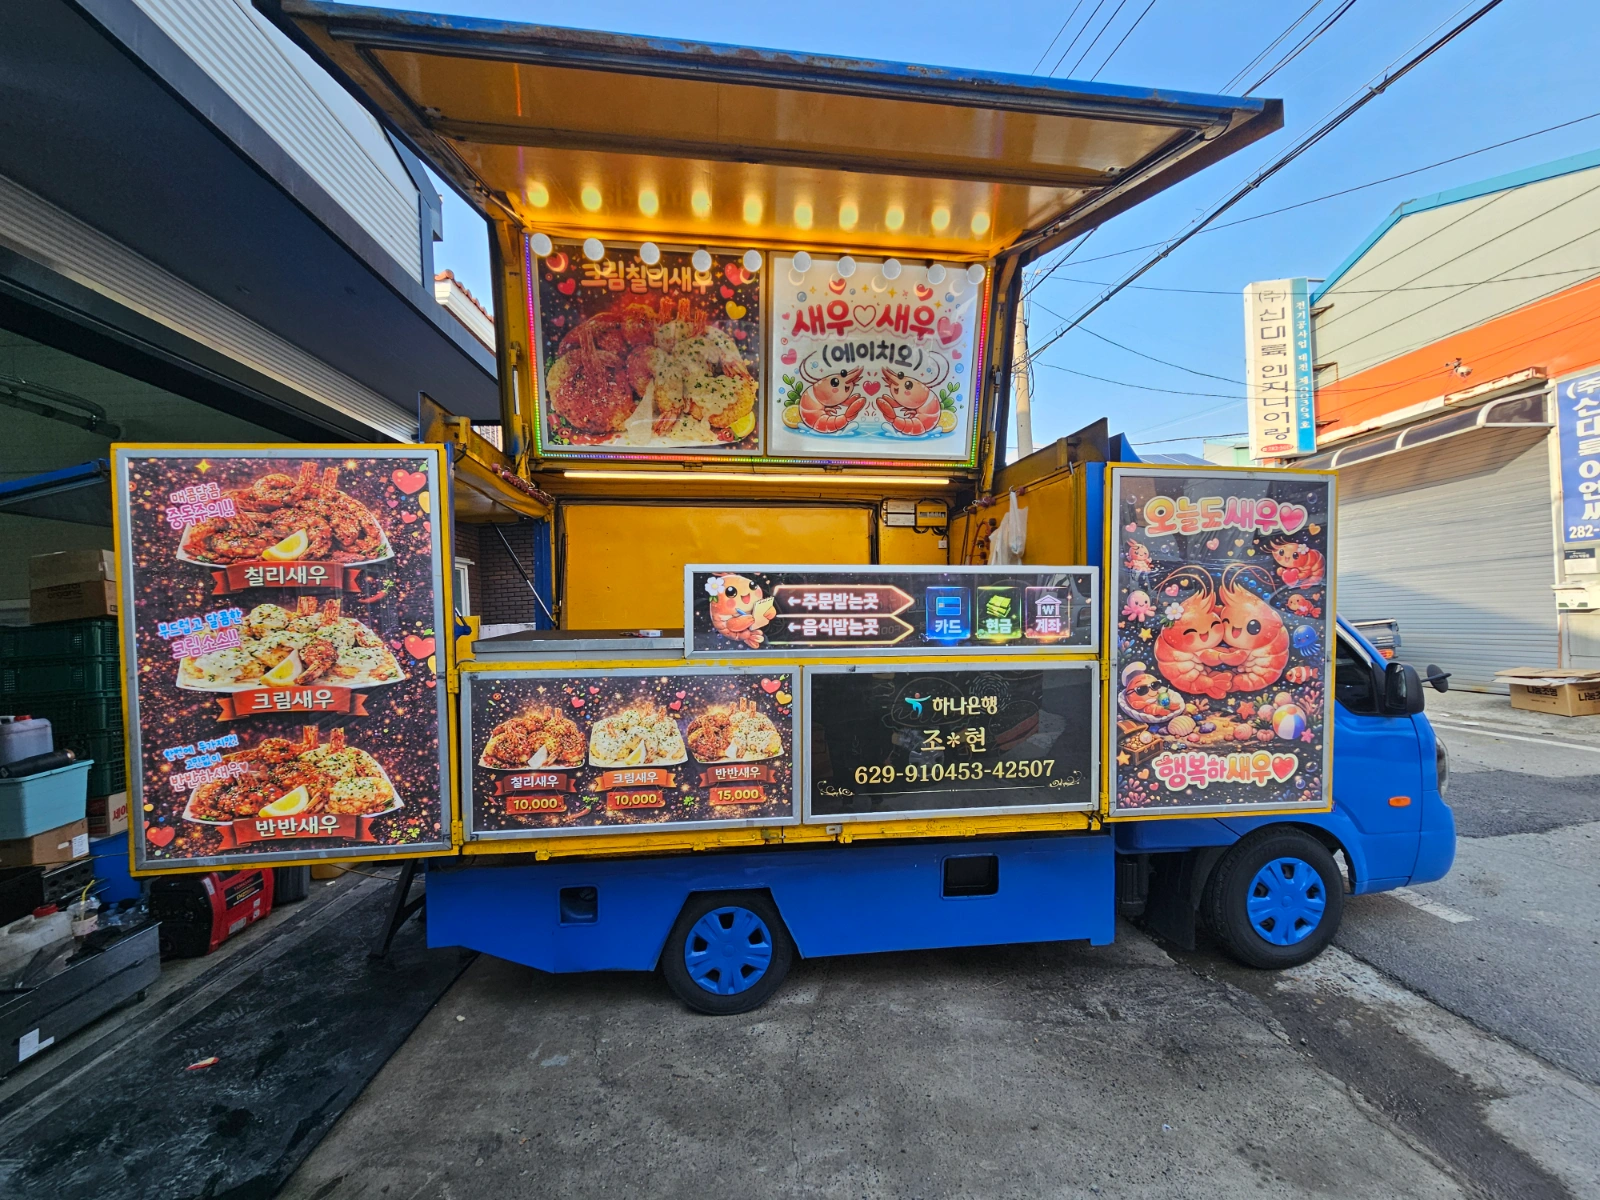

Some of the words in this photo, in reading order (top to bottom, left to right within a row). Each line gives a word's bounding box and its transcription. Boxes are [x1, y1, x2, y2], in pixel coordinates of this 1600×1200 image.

[581, 260, 714, 295] 크림칠리새우
[792, 300, 854, 337] 새우
[876, 303, 935, 341] 새우
[822, 340, 924, 371] (에이치오)
[170, 482, 220, 504] 매콤달콤
[166, 498, 236, 530] 중독주의!!
[244, 565, 329, 587] 칠리새우
[801, 593, 879, 611] 주문받는곳
[158, 617, 204, 640] 부드럽고
[205, 607, 243, 630] 달콤한
[801, 617, 880, 636] 음식받는곳
[934, 618, 963, 635] 카드
[985, 618, 1013, 634] 현금
[1035, 618, 1062, 634] 계좌
[172, 629, 241, 660] 크림소스!!
[251, 689, 335, 711] 크림새우
[932, 695, 998, 716] 하나은행
[510, 773, 560, 789] 칠리새우
[612, 771, 659, 785] 크림새우
[715, 765, 762, 780] 반반새우
[854, 759, 1056, 785] 629-910453-42507
[513, 798, 558, 810] 10,000
[614, 793, 658, 806] 10,000
[717, 788, 759, 802] 15,000
[255, 816, 341, 837] 반반새우
